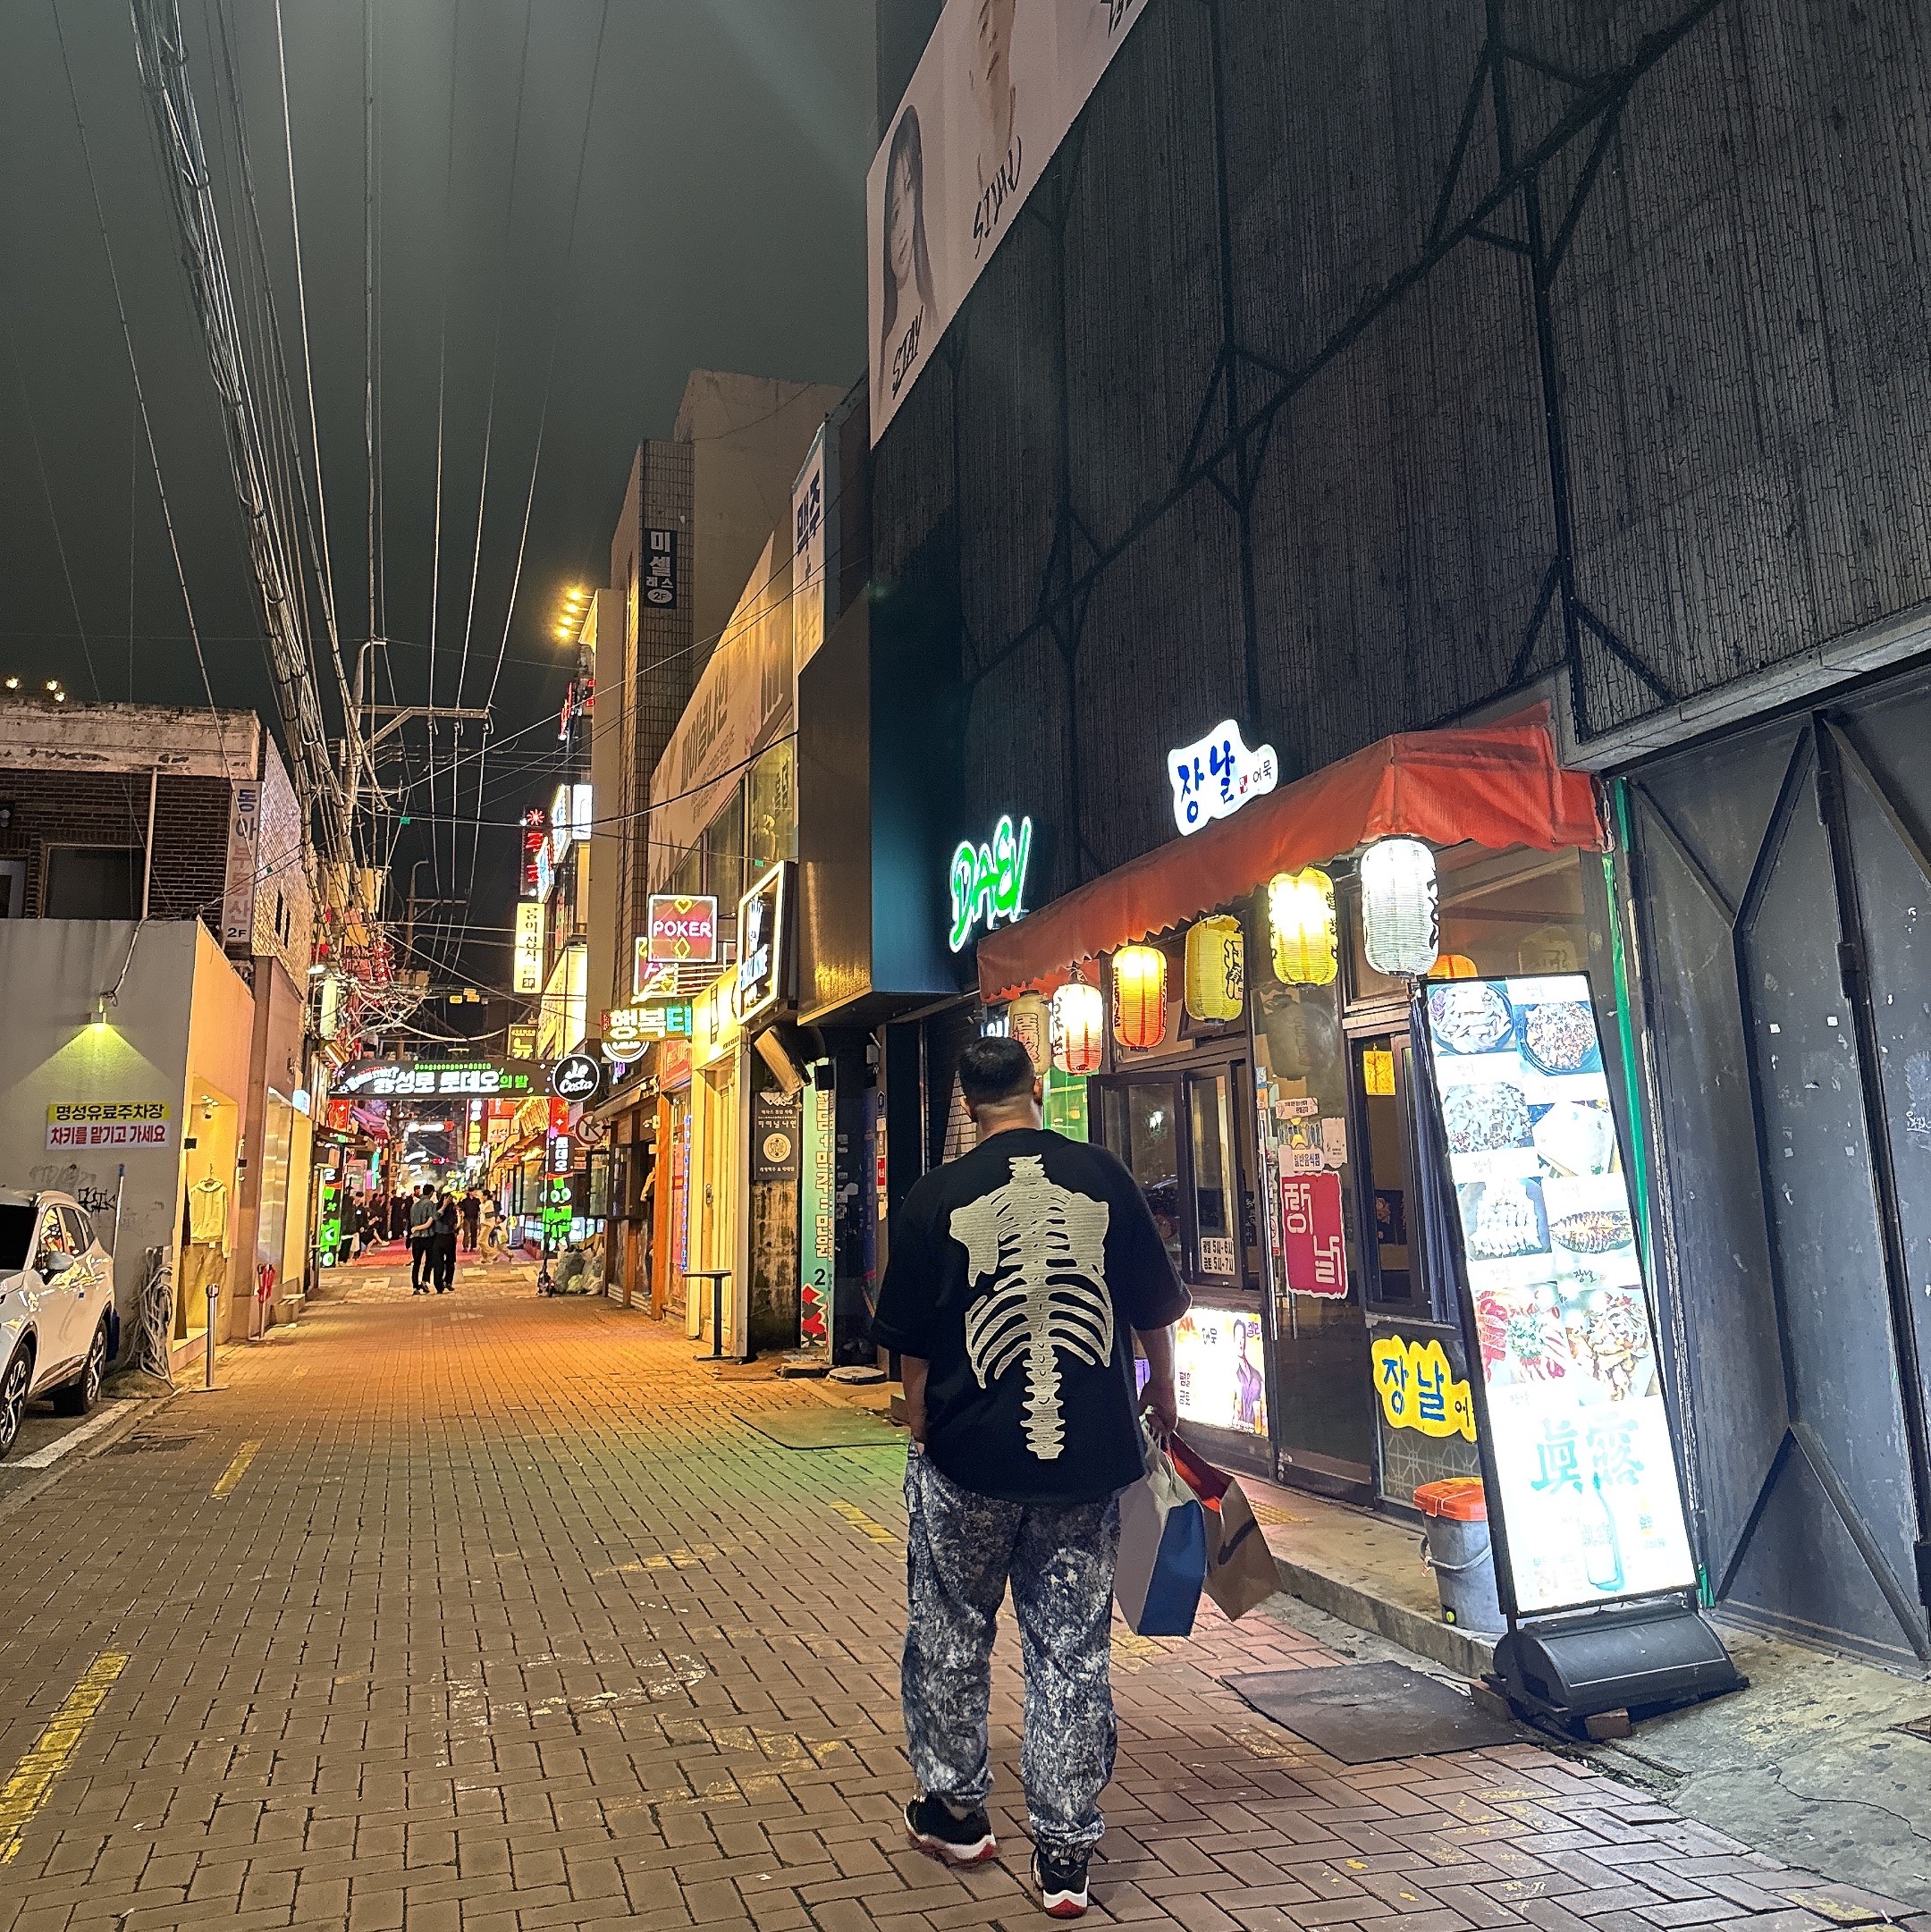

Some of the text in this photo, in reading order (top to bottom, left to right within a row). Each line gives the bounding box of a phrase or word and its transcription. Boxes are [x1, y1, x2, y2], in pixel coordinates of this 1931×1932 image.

[653, 591, 668, 602] 2F
[1176, 739, 1272, 823] 장날 어묵
[229, 789, 257, 924] 동아 부동산
[227, 927, 248, 939] 2F
[653, 920, 713, 938] POKER
[56, 1104, 164, 1121] 명성유료주차장
[50, 1126, 88, 1145] 차키를
[130, 1125, 166, 1143] 가세요
[1382, 1354, 1446, 1422] 장날
